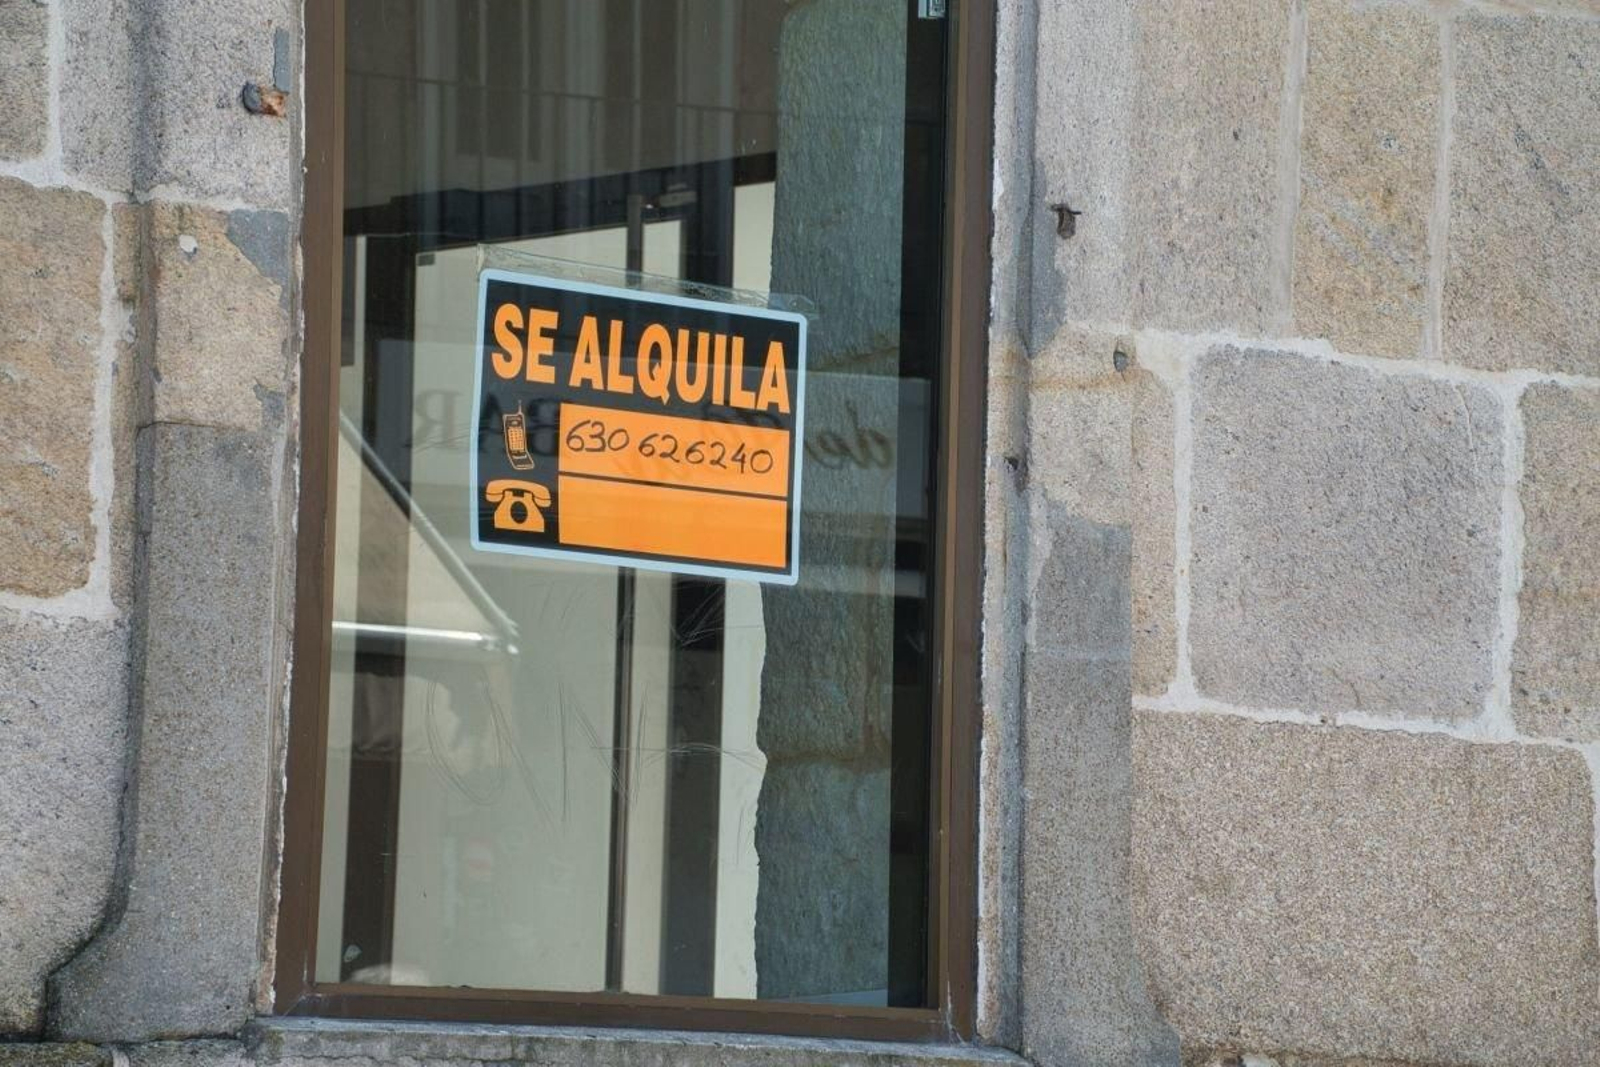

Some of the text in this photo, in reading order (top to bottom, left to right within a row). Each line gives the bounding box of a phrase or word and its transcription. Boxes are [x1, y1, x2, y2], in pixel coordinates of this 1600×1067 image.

[492, 303, 791, 413] SE ALQUILA
[566, 421, 774, 474] 630 626240
